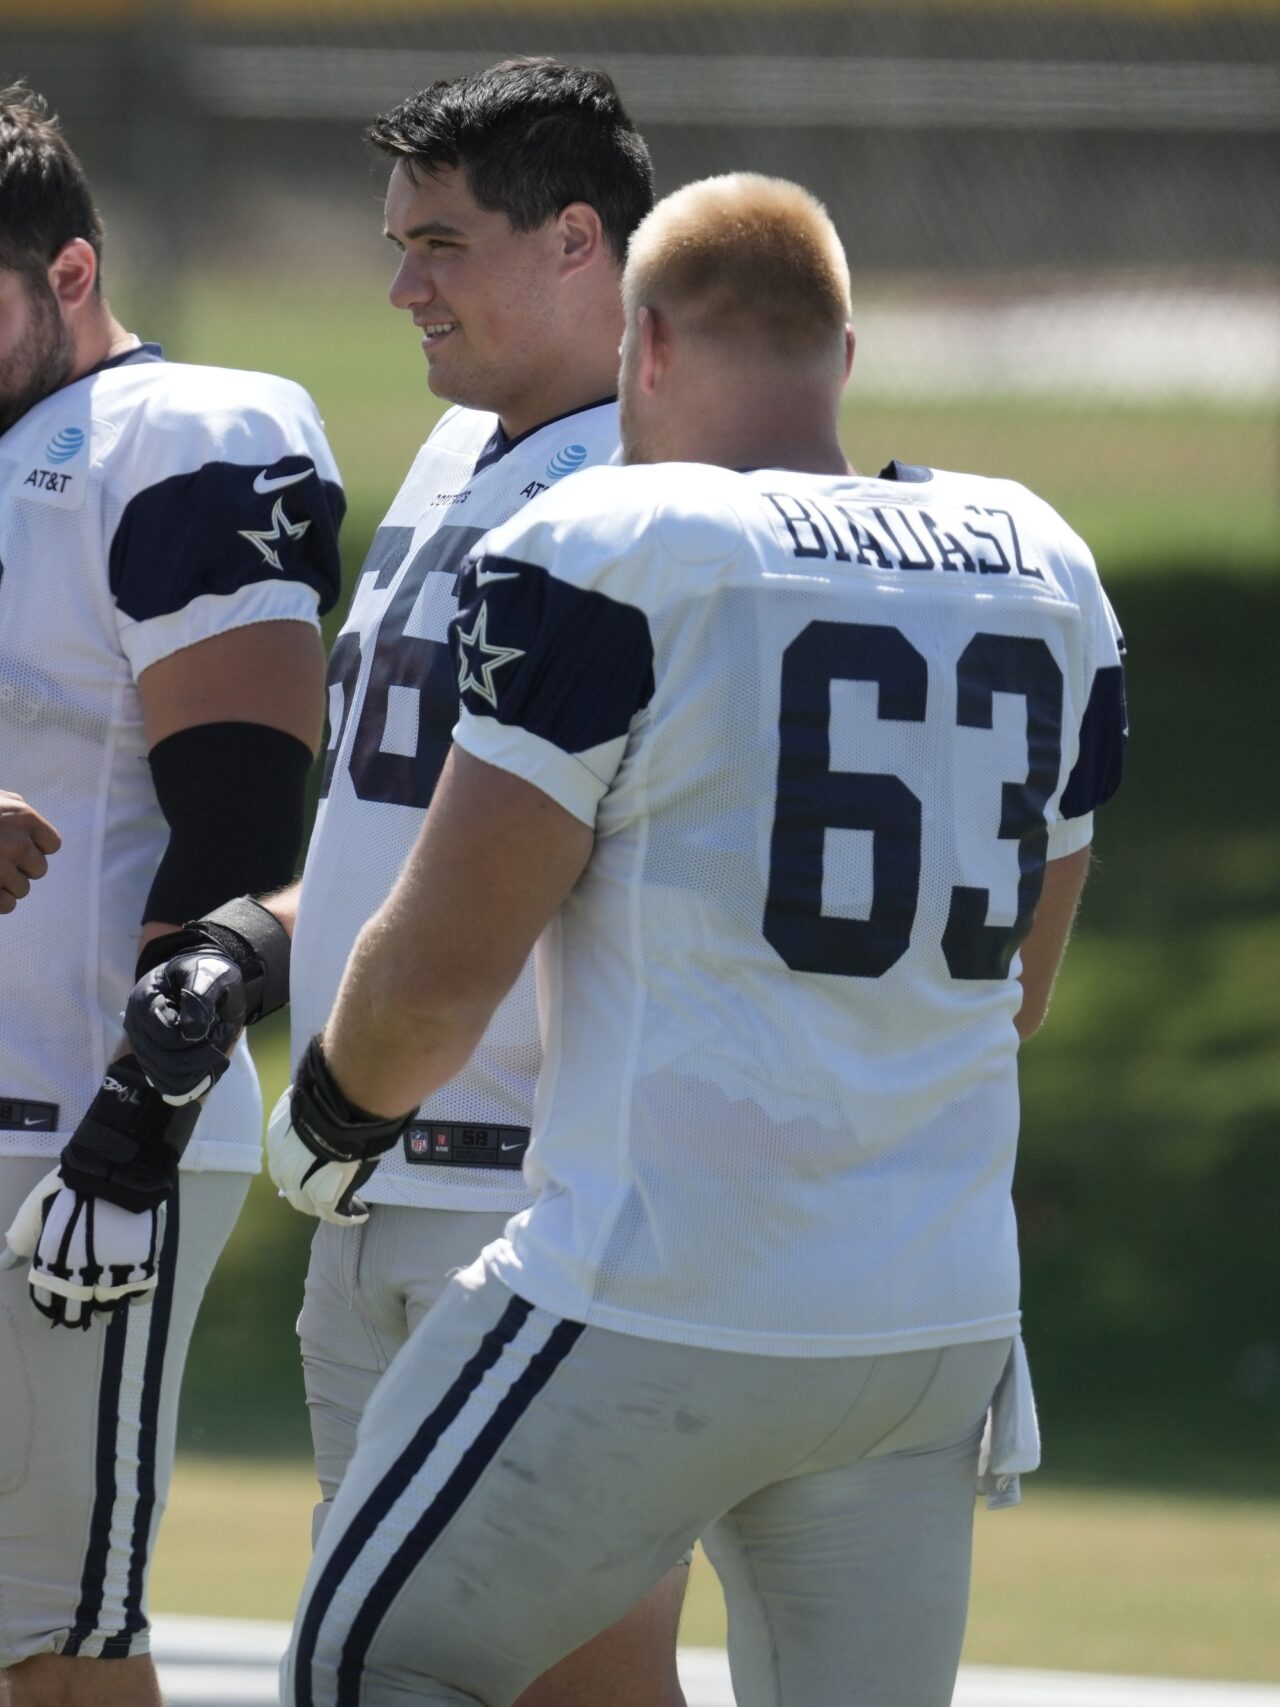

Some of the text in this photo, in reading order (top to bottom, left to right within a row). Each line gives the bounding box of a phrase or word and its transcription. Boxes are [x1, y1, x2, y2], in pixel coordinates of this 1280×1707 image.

[24, 469, 72, 493] AT&T
[520, 480, 550, 500] AT
[761, 492, 1045, 582] BIADASZ
[762, 619, 1065, 981] 63
